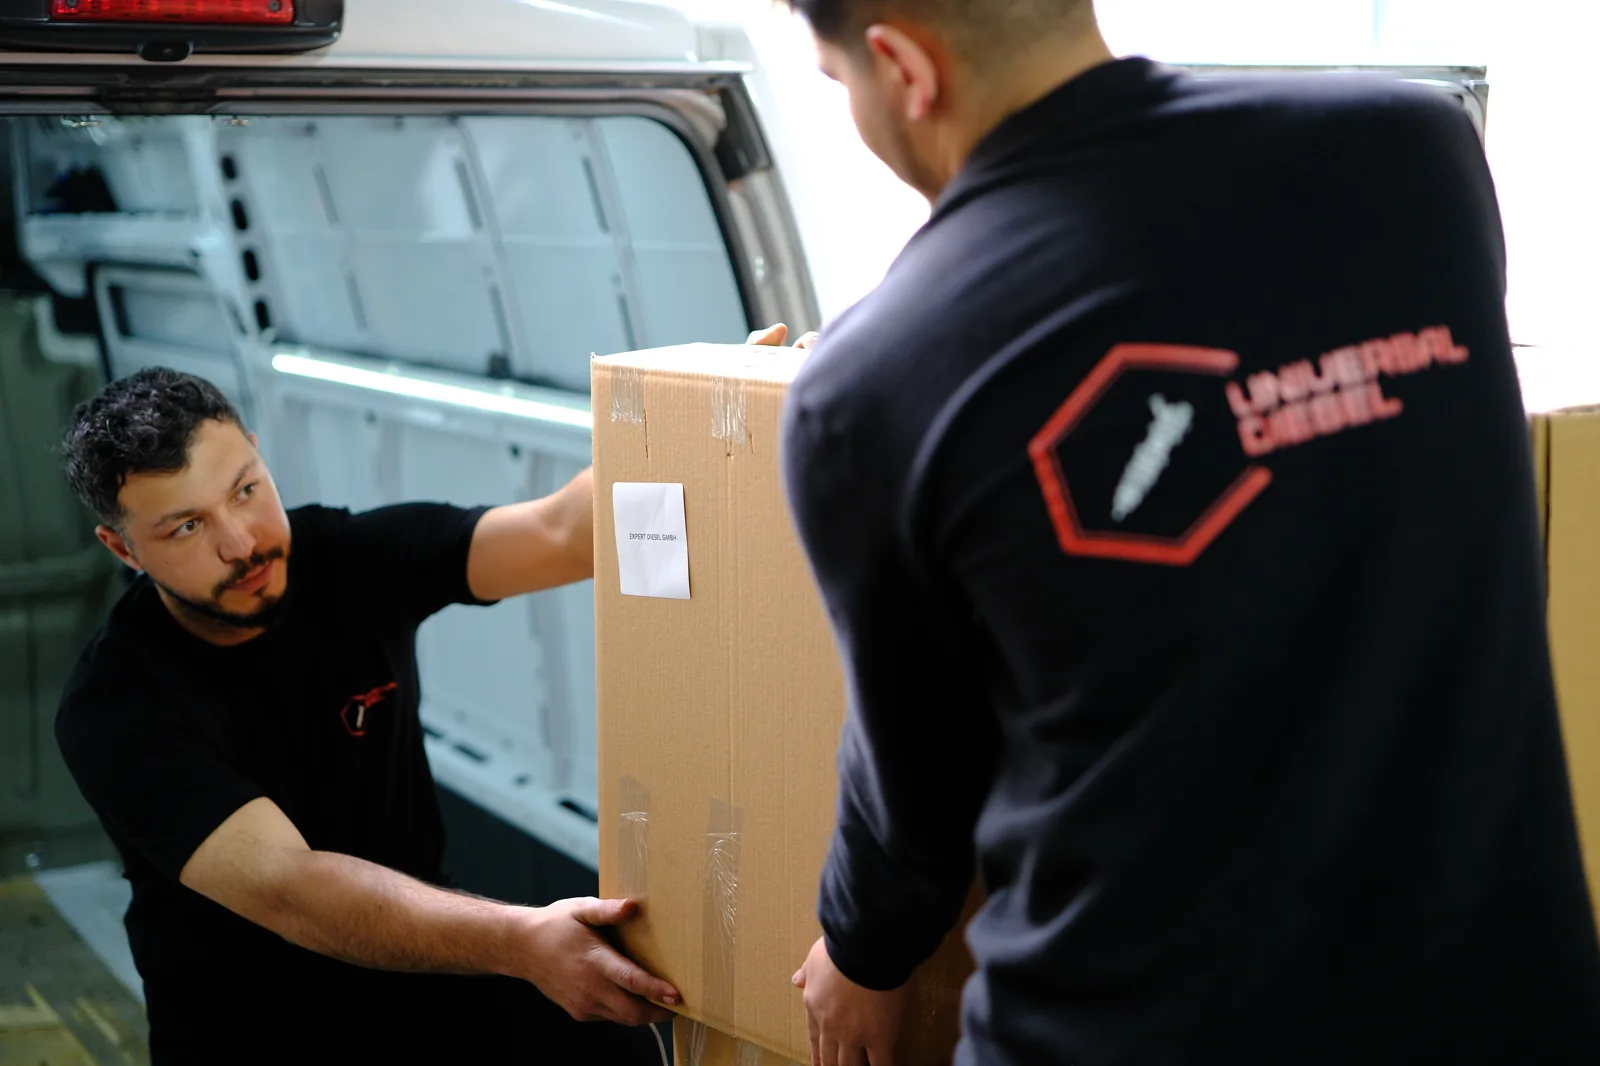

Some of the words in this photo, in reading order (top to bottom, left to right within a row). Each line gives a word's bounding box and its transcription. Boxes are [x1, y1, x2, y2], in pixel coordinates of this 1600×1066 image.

[1225, 324, 1470, 418] UNIVERSAL
[1236, 382, 1404, 457] DIESEL
[647, 533, 661, 541] DIESEL
